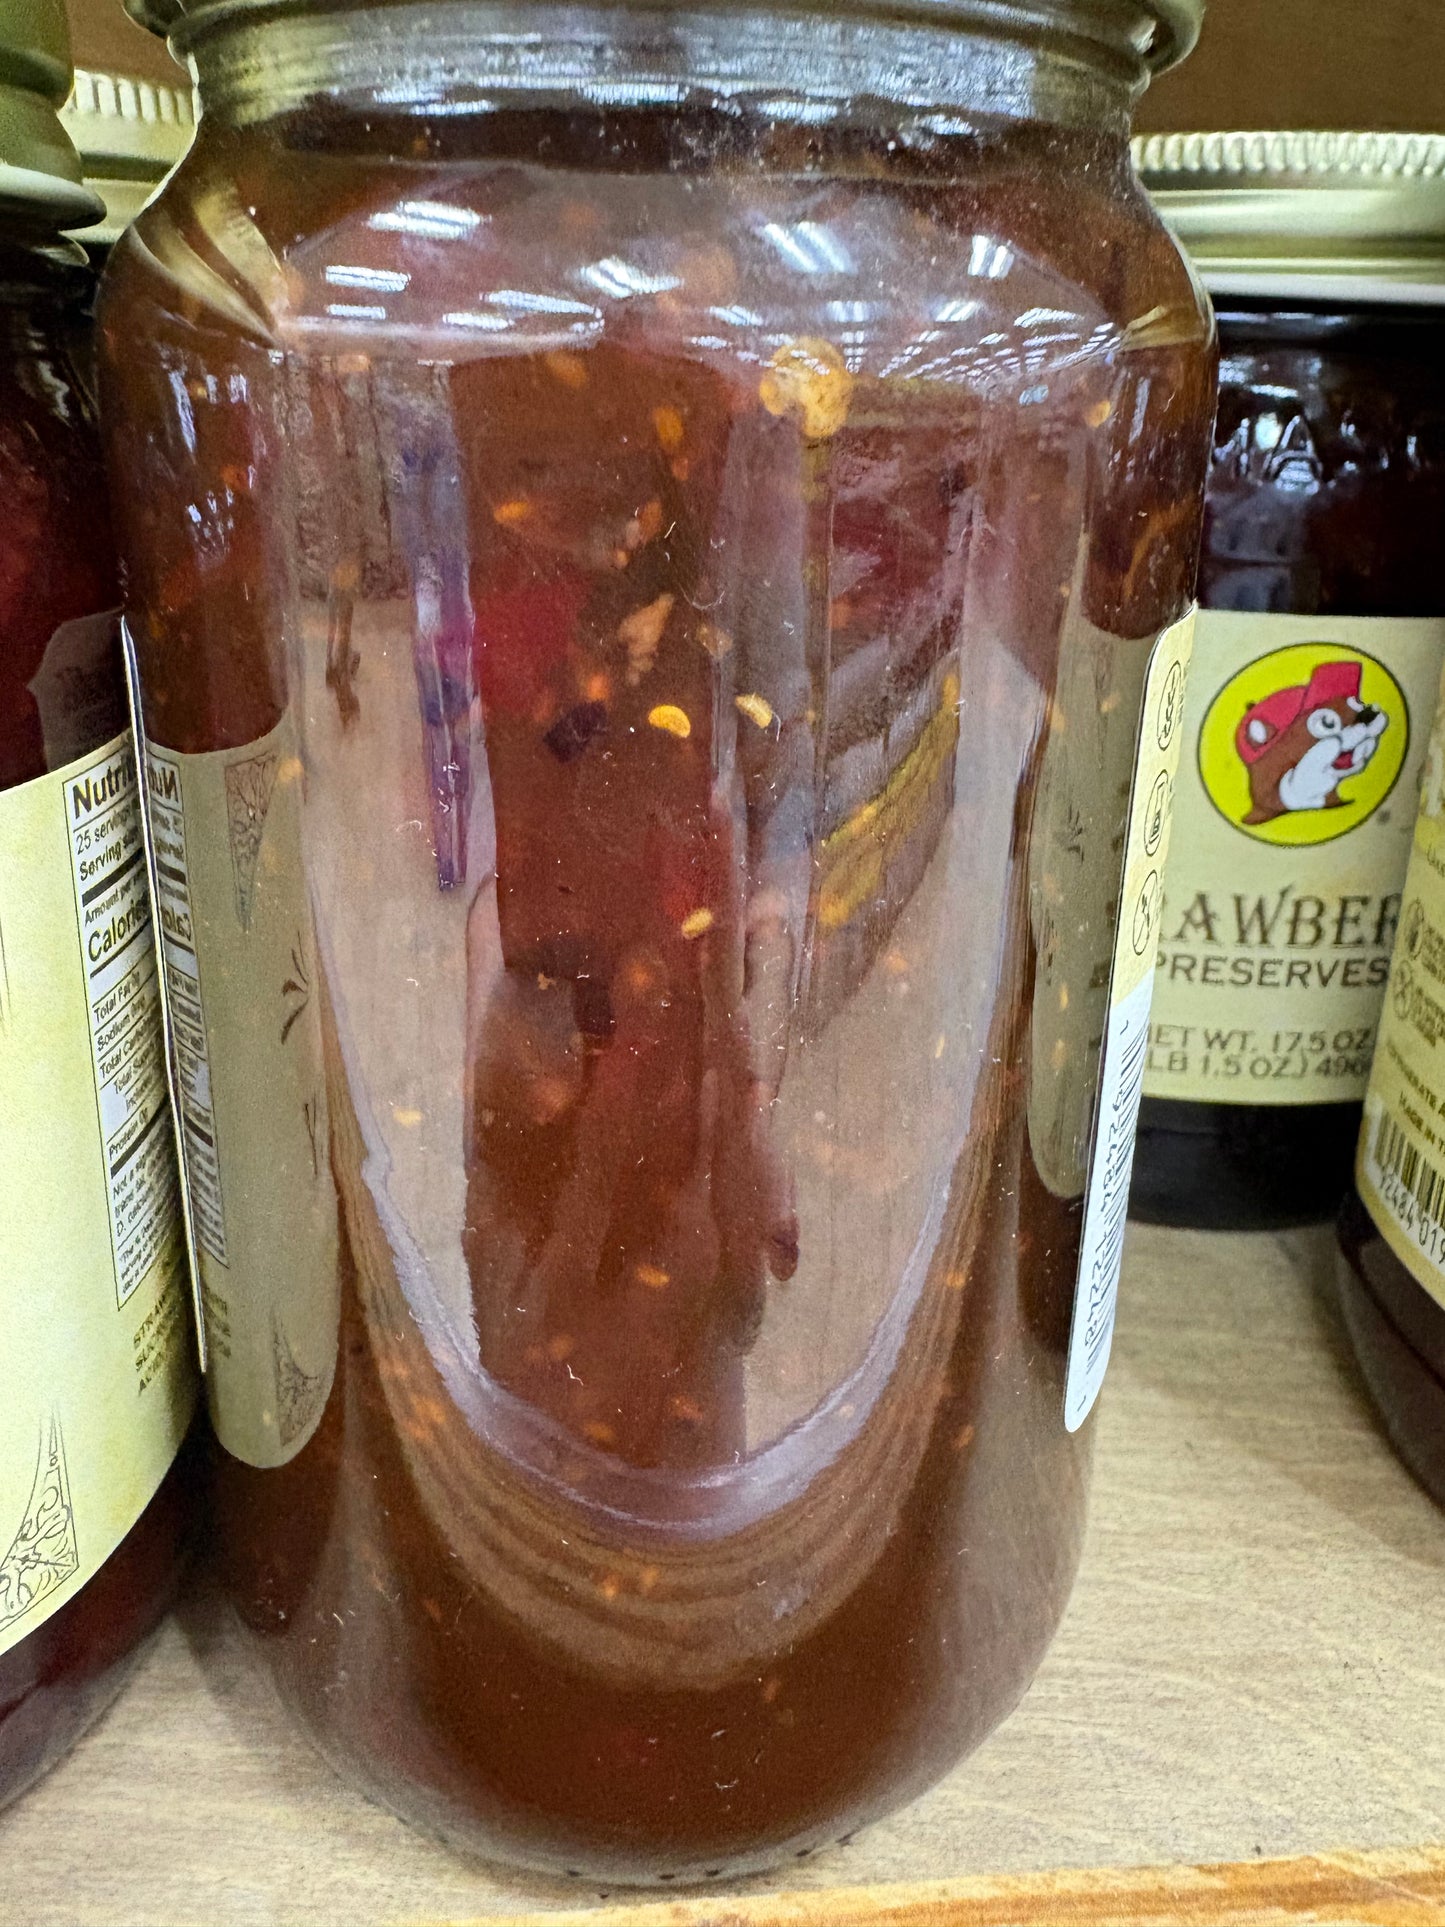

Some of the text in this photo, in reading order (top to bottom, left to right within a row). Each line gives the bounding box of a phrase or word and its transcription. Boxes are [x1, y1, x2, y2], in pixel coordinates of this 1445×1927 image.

[73, 754, 137, 820] Nutri
[76, 829, 92, 855] 25
[80, 839, 122, 881] Serving
[1160, 883, 1402, 948] AWBER
[94, 993, 117, 1024] Total
[1148, 1022, 1196, 1047] ET
[100, 1048, 122, 1078] Total
